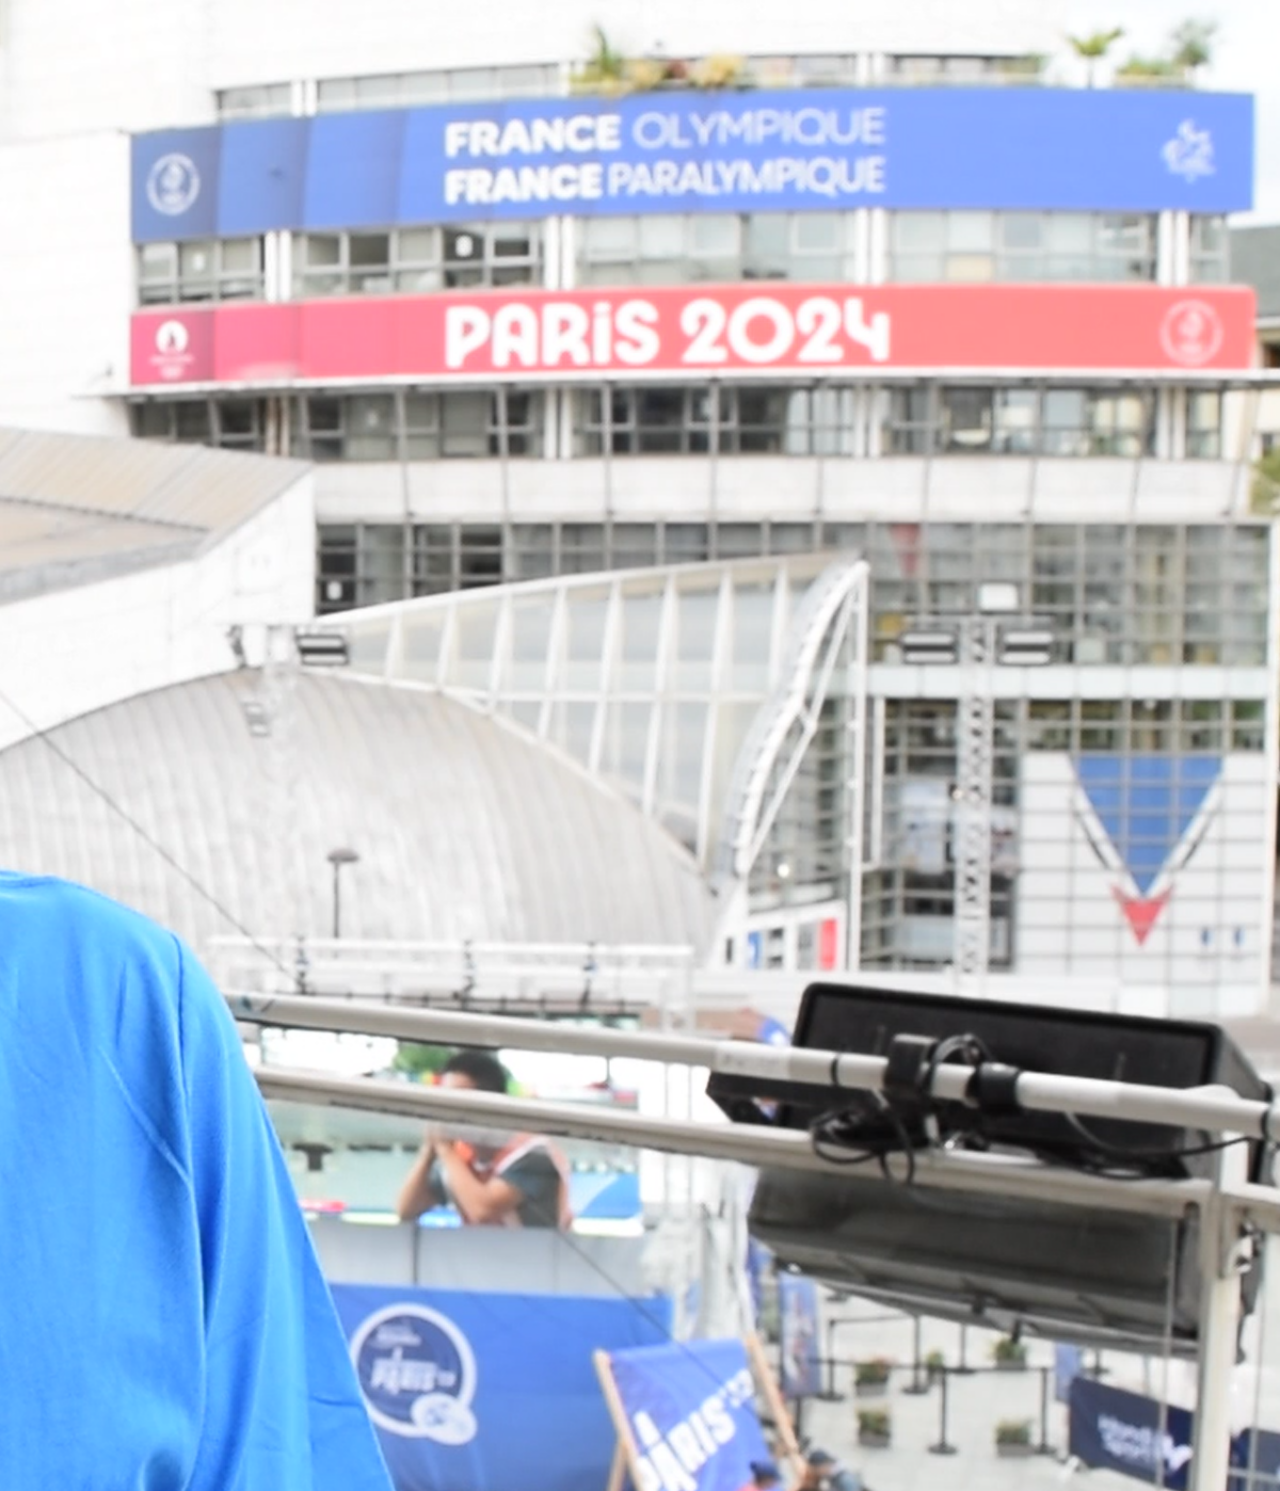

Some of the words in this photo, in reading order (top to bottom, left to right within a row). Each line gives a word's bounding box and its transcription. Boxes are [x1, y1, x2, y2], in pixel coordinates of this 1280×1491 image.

[445, 113, 620, 156] FRANCE
[632, 107, 887, 150] OLYMPIQUE
[445, 163, 603, 204] FRANCE
[608, 156, 887, 198] PARALYMPIQUE
[680, 297, 891, 364] 2024
